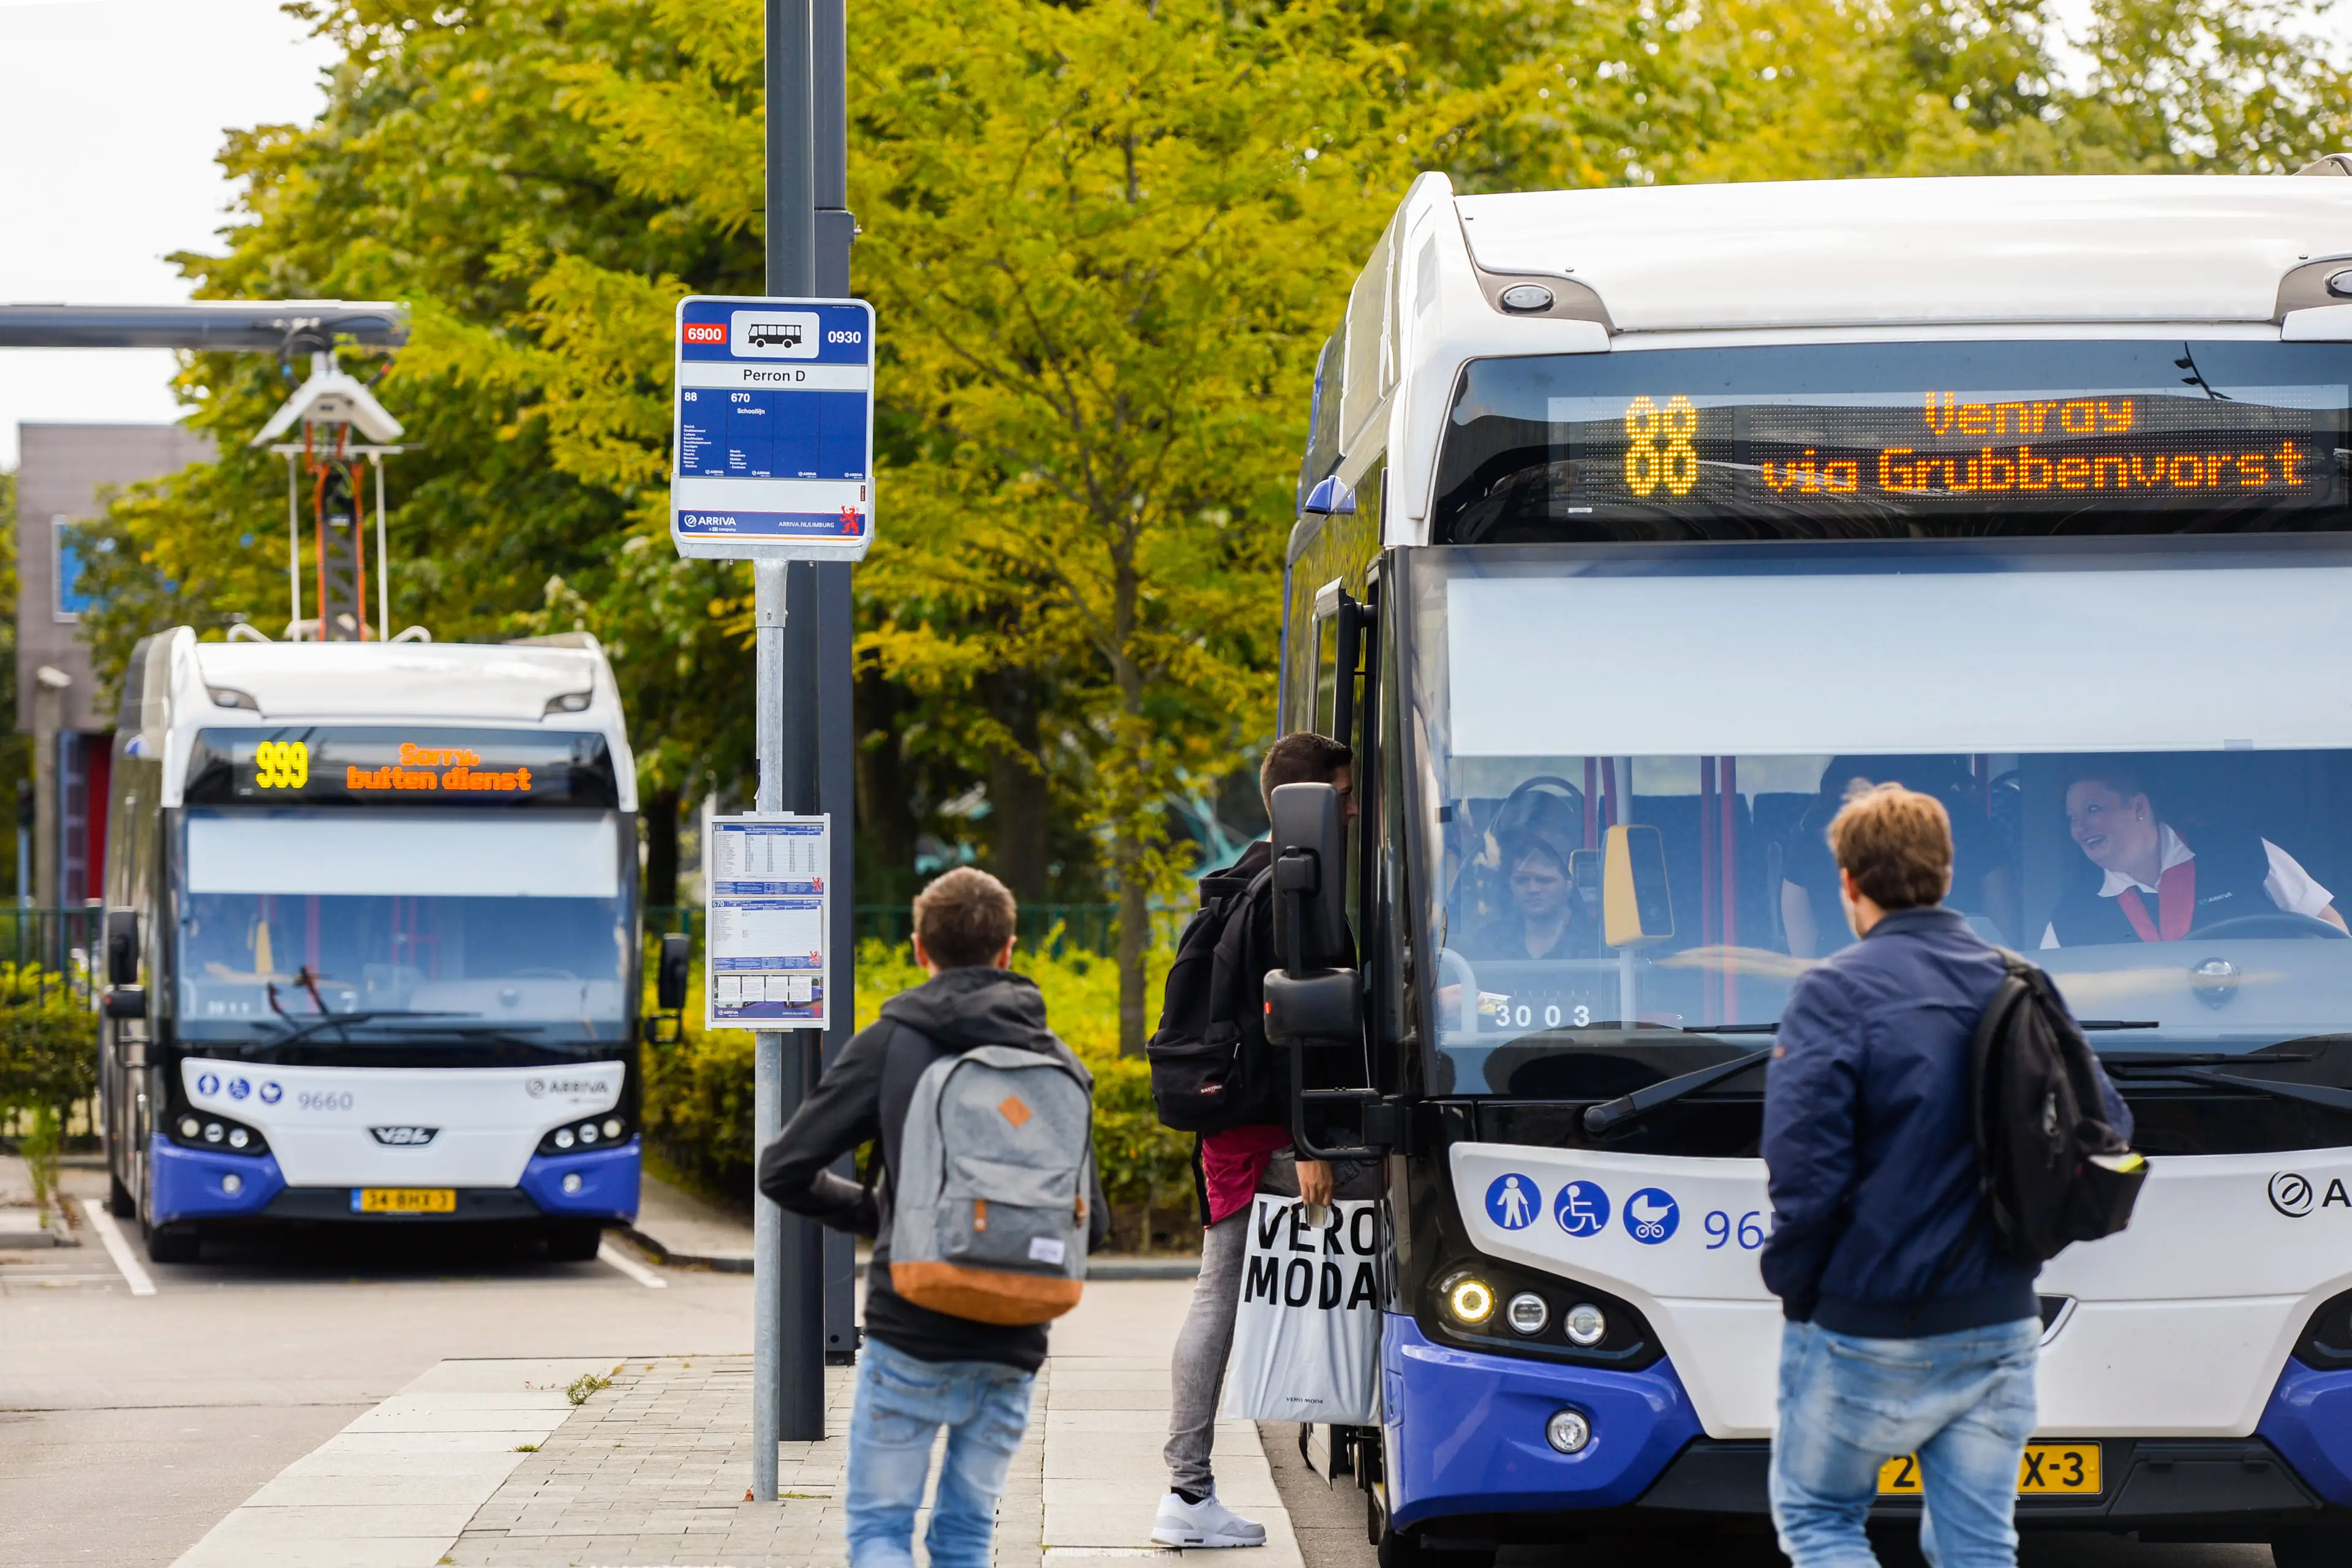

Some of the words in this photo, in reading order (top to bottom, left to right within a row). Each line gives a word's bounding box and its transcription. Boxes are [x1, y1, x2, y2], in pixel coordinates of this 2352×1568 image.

[687, 327, 722, 341] 6900
[827, 330, 862, 344] 0930
[743, 369, 791, 382] Perron
[796, 371, 806, 382] D
[684, 392, 698, 401] 88
[731, 393, 750, 402] 670
[1924, 390, 2134, 435] Venray
[1624, 395, 1697, 496] 88
[1762, 449, 1859, 495] via
[1877, 440, 2304, 492] Grubbenvorst
[698, 516, 736, 526] ARRIVA
[257, 741, 308, 788] 999
[400, 743, 480, 767] Sorry,
[347, 767, 437, 790] buiten
[442, 768, 532, 791] dienst
[2209, 892, 2233, 902] ARRIVA
[550, 1081, 609, 1092] ARRIVA
[298, 1091, 354, 1110] 9660
[1257, 1201, 1376, 1256] VERO
[1244, 1255, 1377, 1310] MODA
